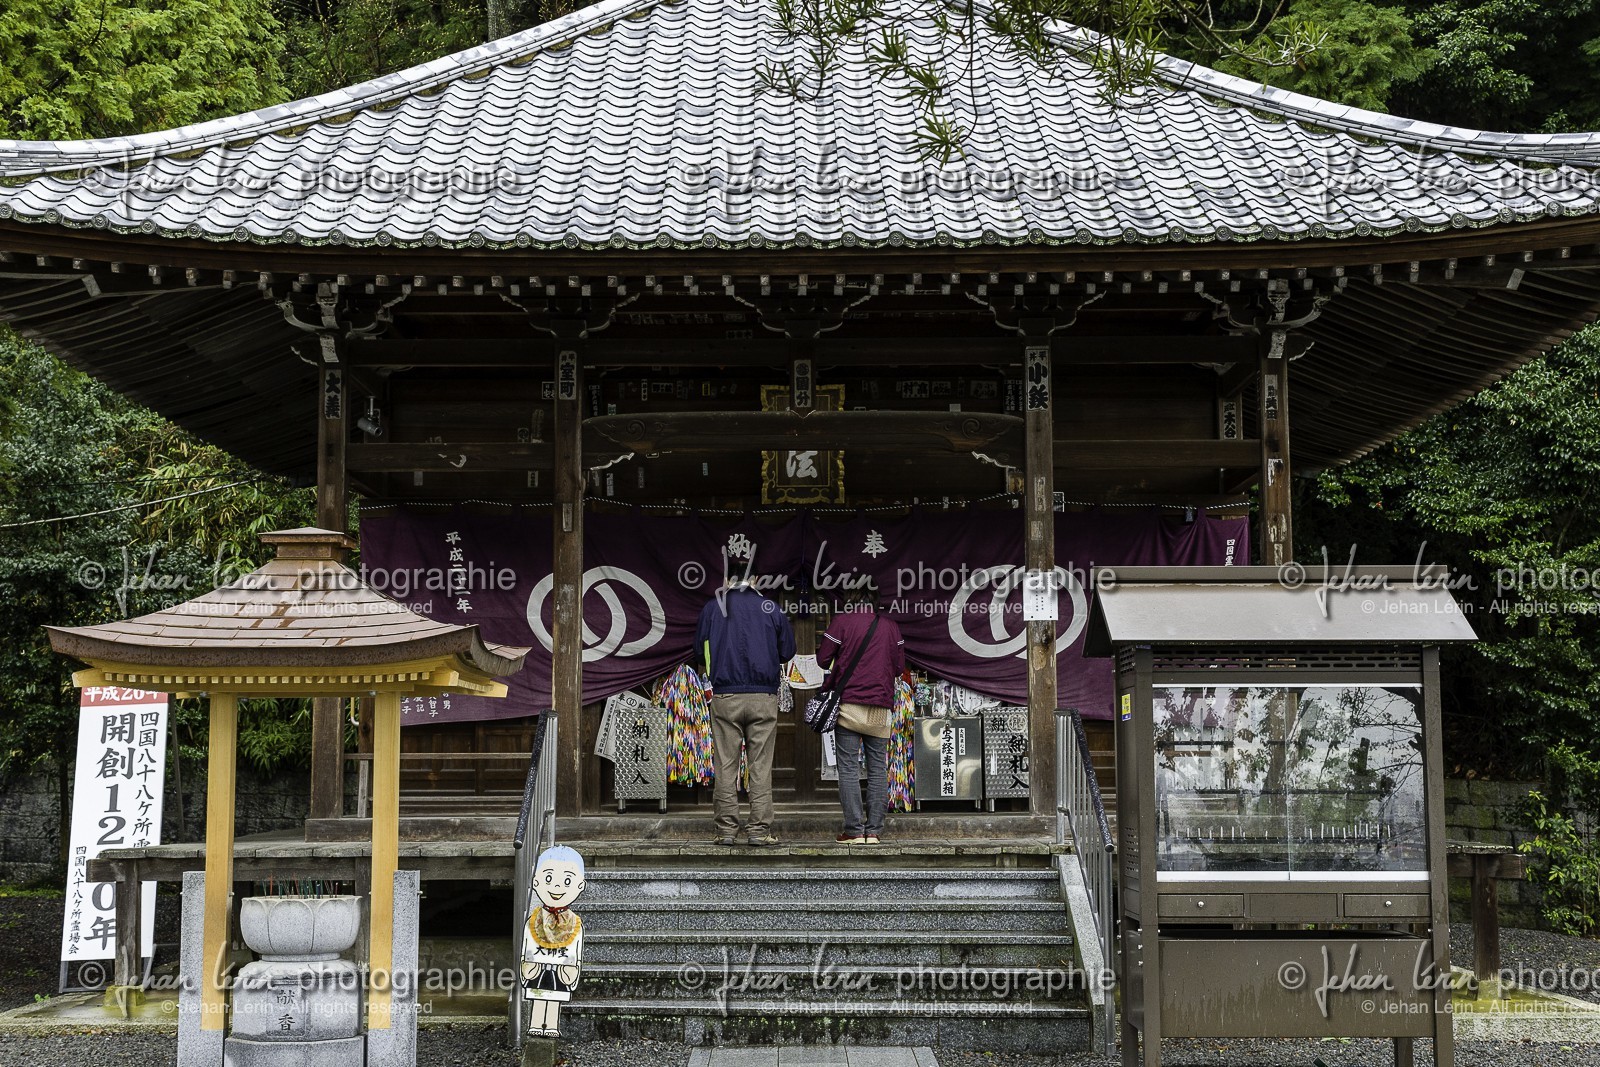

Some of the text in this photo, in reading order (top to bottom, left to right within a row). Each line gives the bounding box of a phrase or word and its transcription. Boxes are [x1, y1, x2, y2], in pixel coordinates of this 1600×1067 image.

[786, 451, 818, 478] 法
[445, 531, 473, 614] 平成二十二年
[862, 530, 888, 558] 奉
[631, 716, 650, 784] 納札入
[84, 712, 136, 950] 開創120年
